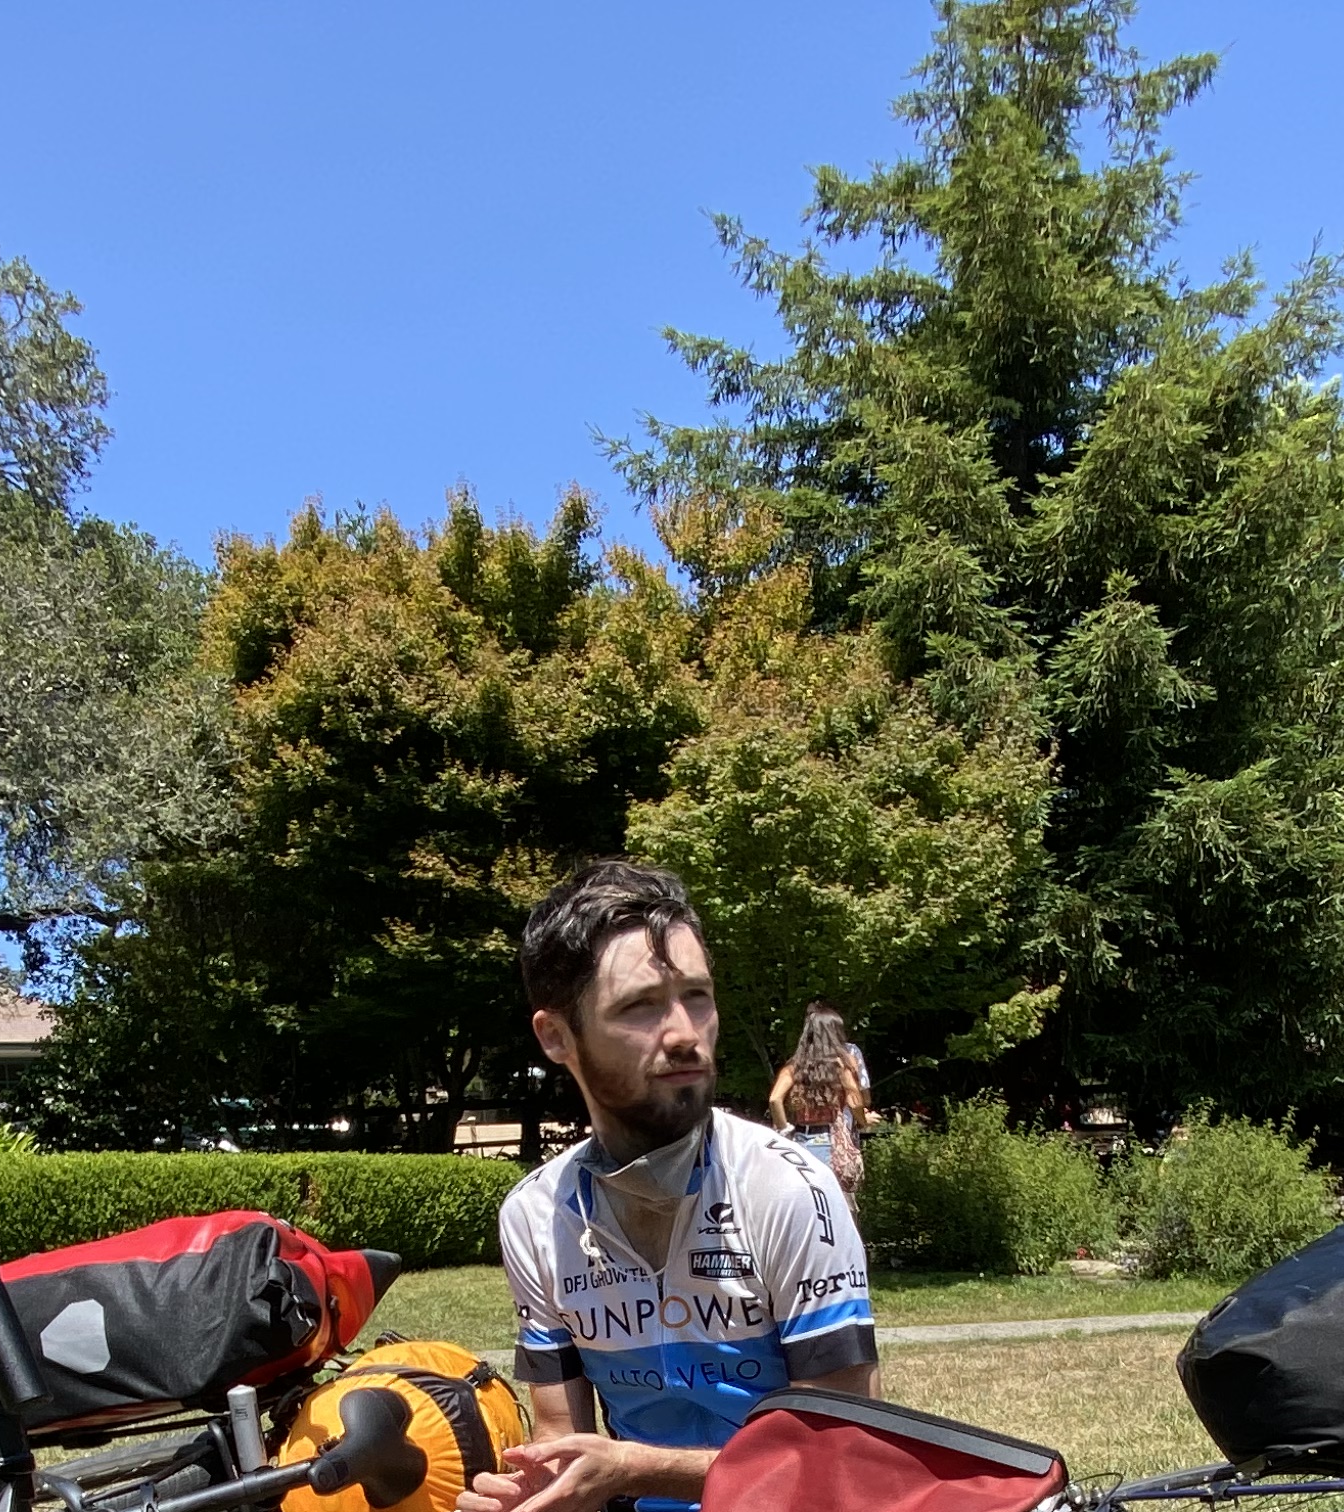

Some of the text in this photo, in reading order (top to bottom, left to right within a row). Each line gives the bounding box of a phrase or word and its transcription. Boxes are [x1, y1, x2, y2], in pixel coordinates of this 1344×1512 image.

[765, 1139, 835, 1247] VOLER
[693, 1254, 752, 1269] HAMMER
[563, 1273, 588, 1294] DFJ
[558, 1293, 774, 1341] SUNPOWE
[610, 1359, 761, 1391] ALTO VELO
